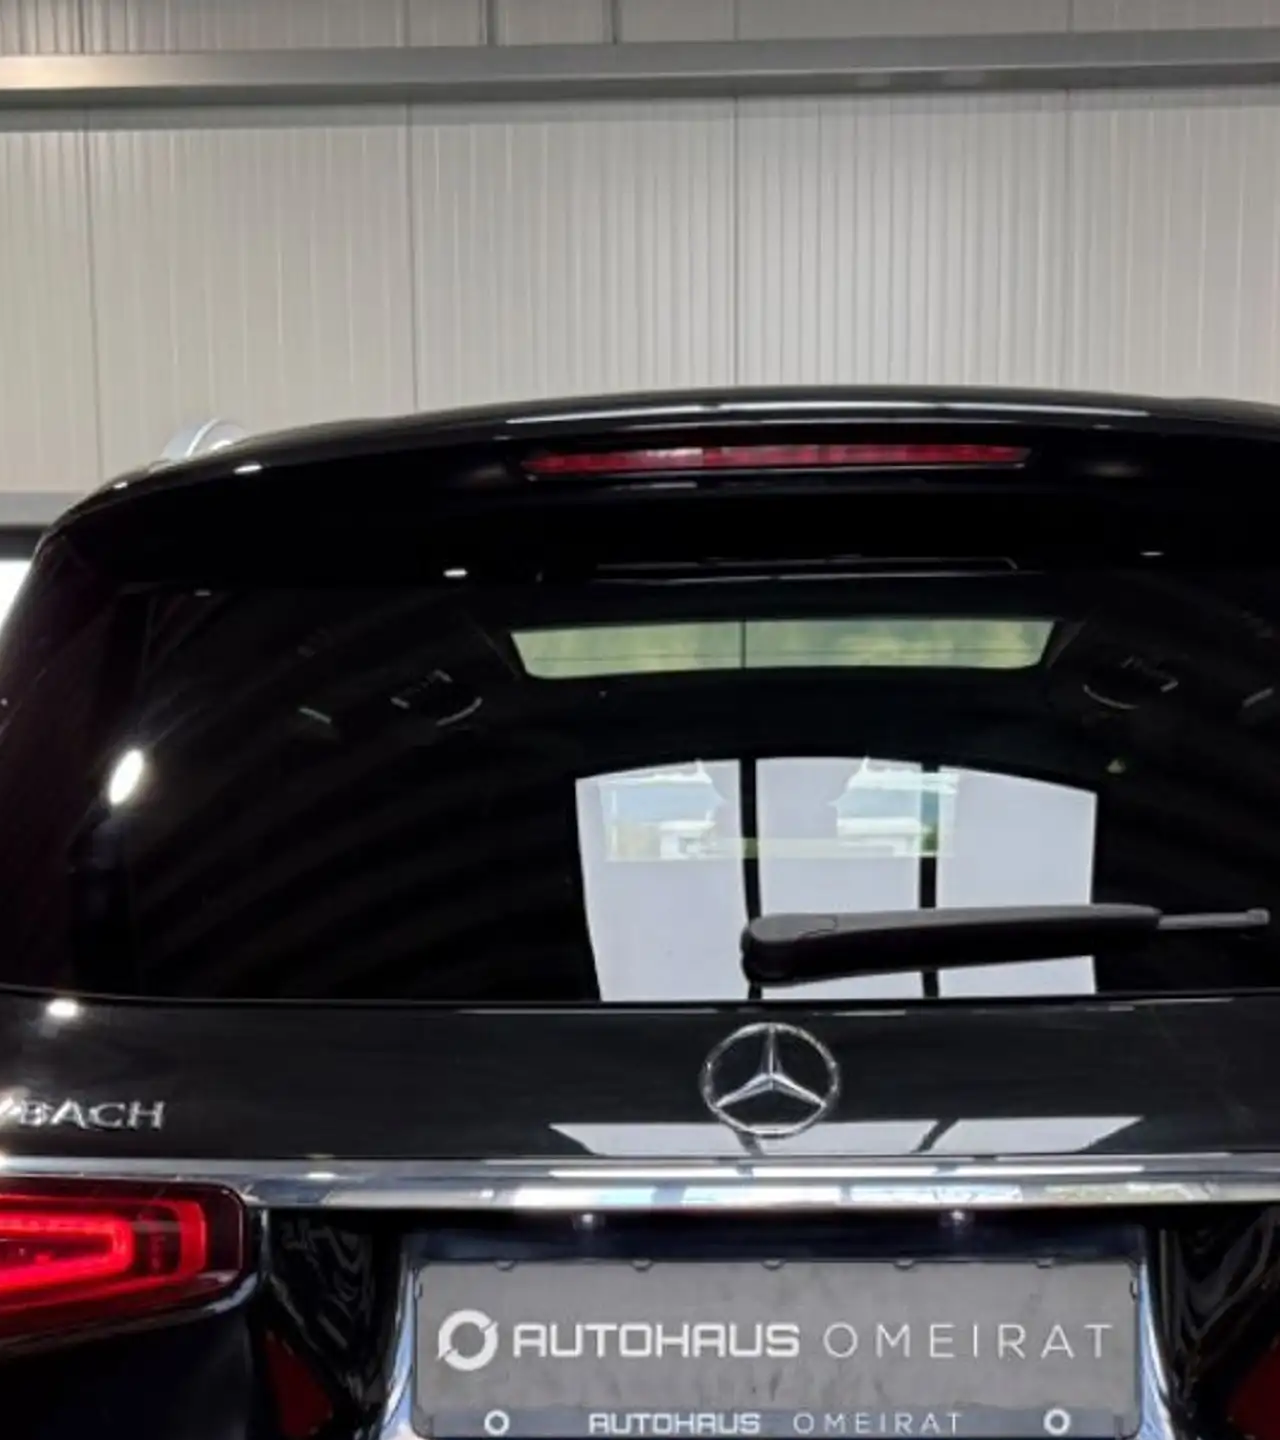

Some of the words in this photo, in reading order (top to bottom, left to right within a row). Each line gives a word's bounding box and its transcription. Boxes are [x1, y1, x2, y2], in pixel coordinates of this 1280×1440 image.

[512, 1322, 801, 1358] AUTOHAUS
[822, 1322, 1114, 1358] OMEIRAT
[588, 1411, 762, 1435] AUTOHAUS
[792, 1411, 963, 1435] OMEIRAT
